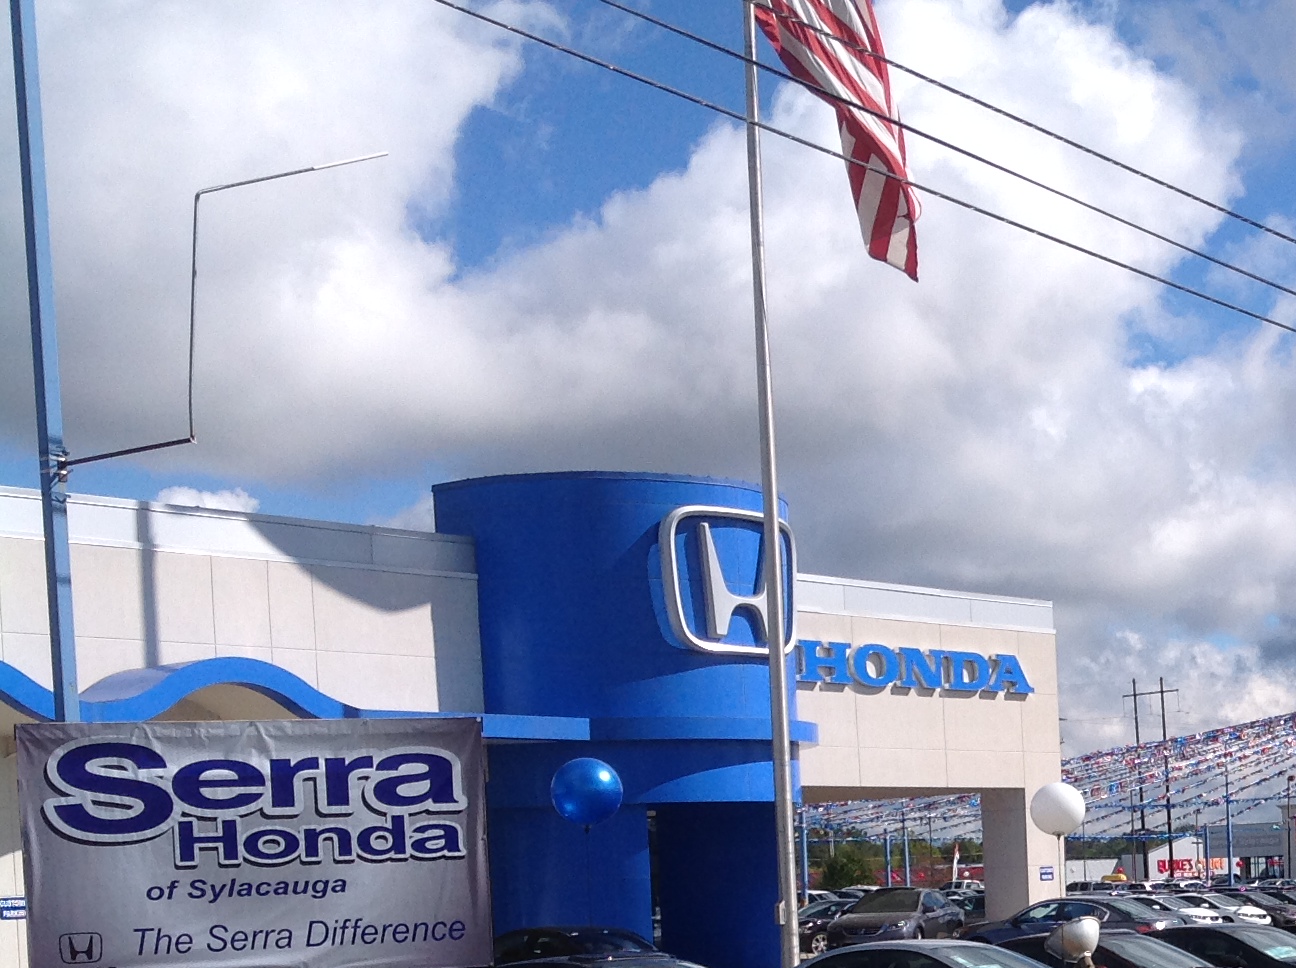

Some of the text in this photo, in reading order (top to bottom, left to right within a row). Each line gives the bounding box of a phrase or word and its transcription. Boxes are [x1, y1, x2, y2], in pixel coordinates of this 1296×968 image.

[797, 639, 1035, 694] HONDA
[45, 737, 465, 842] Serra
[174, 814, 465, 867] Honda
[145, 876, 348, 904] of Sylacauga
[133, 917, 467, 956] The Serra Difference
